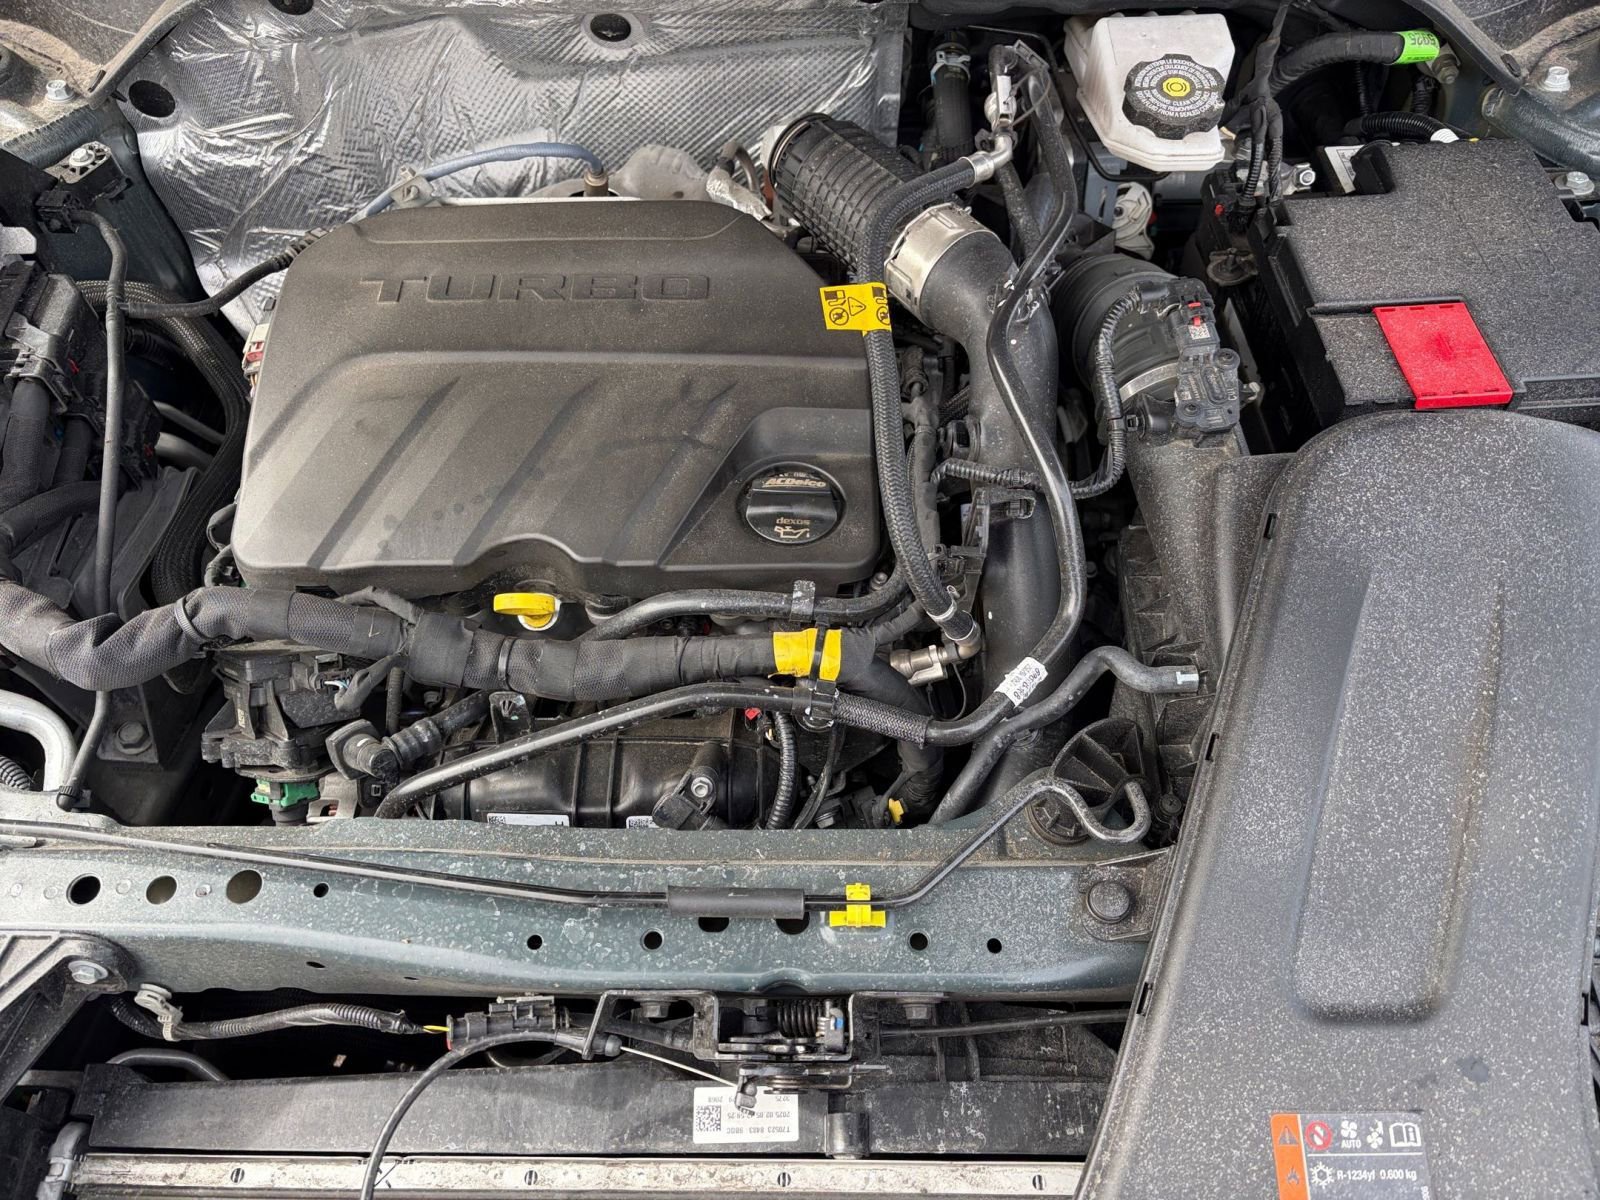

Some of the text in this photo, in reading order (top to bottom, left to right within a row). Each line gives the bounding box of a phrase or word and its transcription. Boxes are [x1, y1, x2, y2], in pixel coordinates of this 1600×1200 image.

[1156, 108, 1174, 116] FROM
[360, 274, 710, 304] TURBO
[762, 477, 827, 488] ACDelco
[775, 517, 811, 525] dexos
[1341, 1140, 1361, 1148] AUTO
[1336, 1169, 1417, 1182] R-1234yf 0.600 kg
